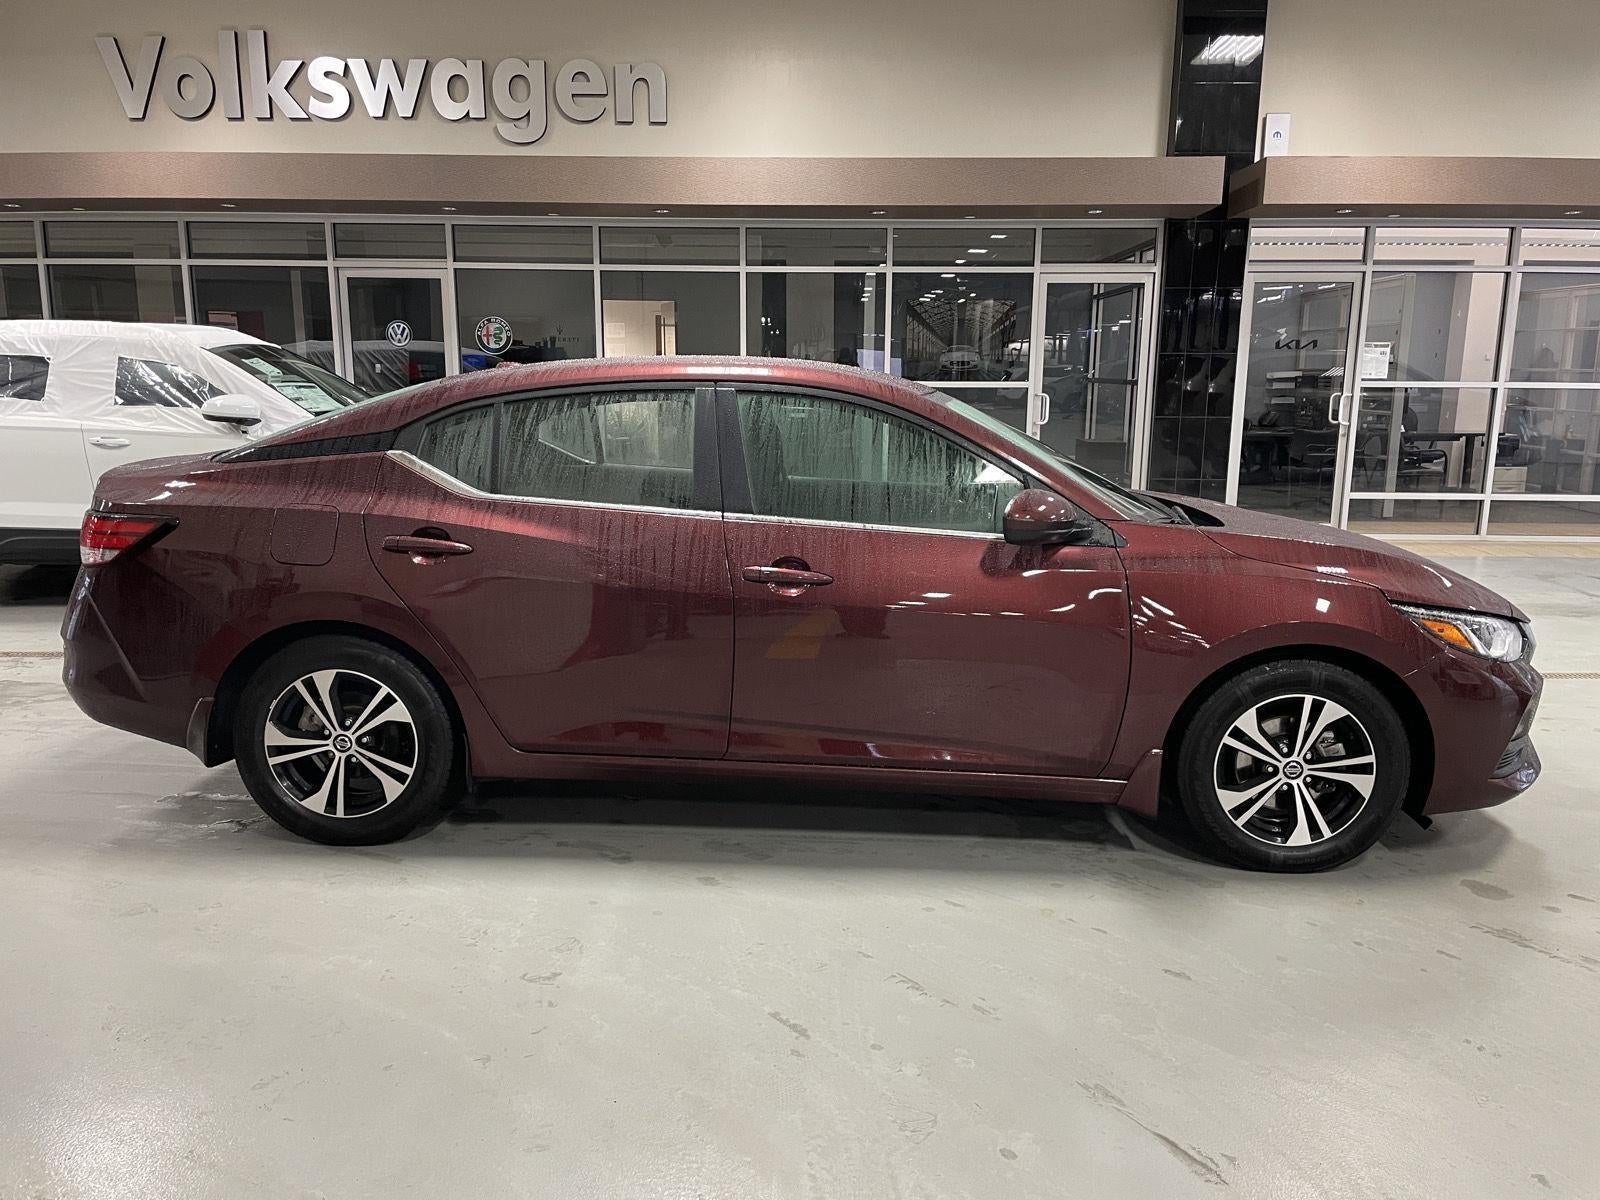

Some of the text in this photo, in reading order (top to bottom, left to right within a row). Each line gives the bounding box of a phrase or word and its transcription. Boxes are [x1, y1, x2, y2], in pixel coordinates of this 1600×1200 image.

[95, 30, 667, 144] Volkswagen
[477, 318, 511, 337] ALFA ROMEO
